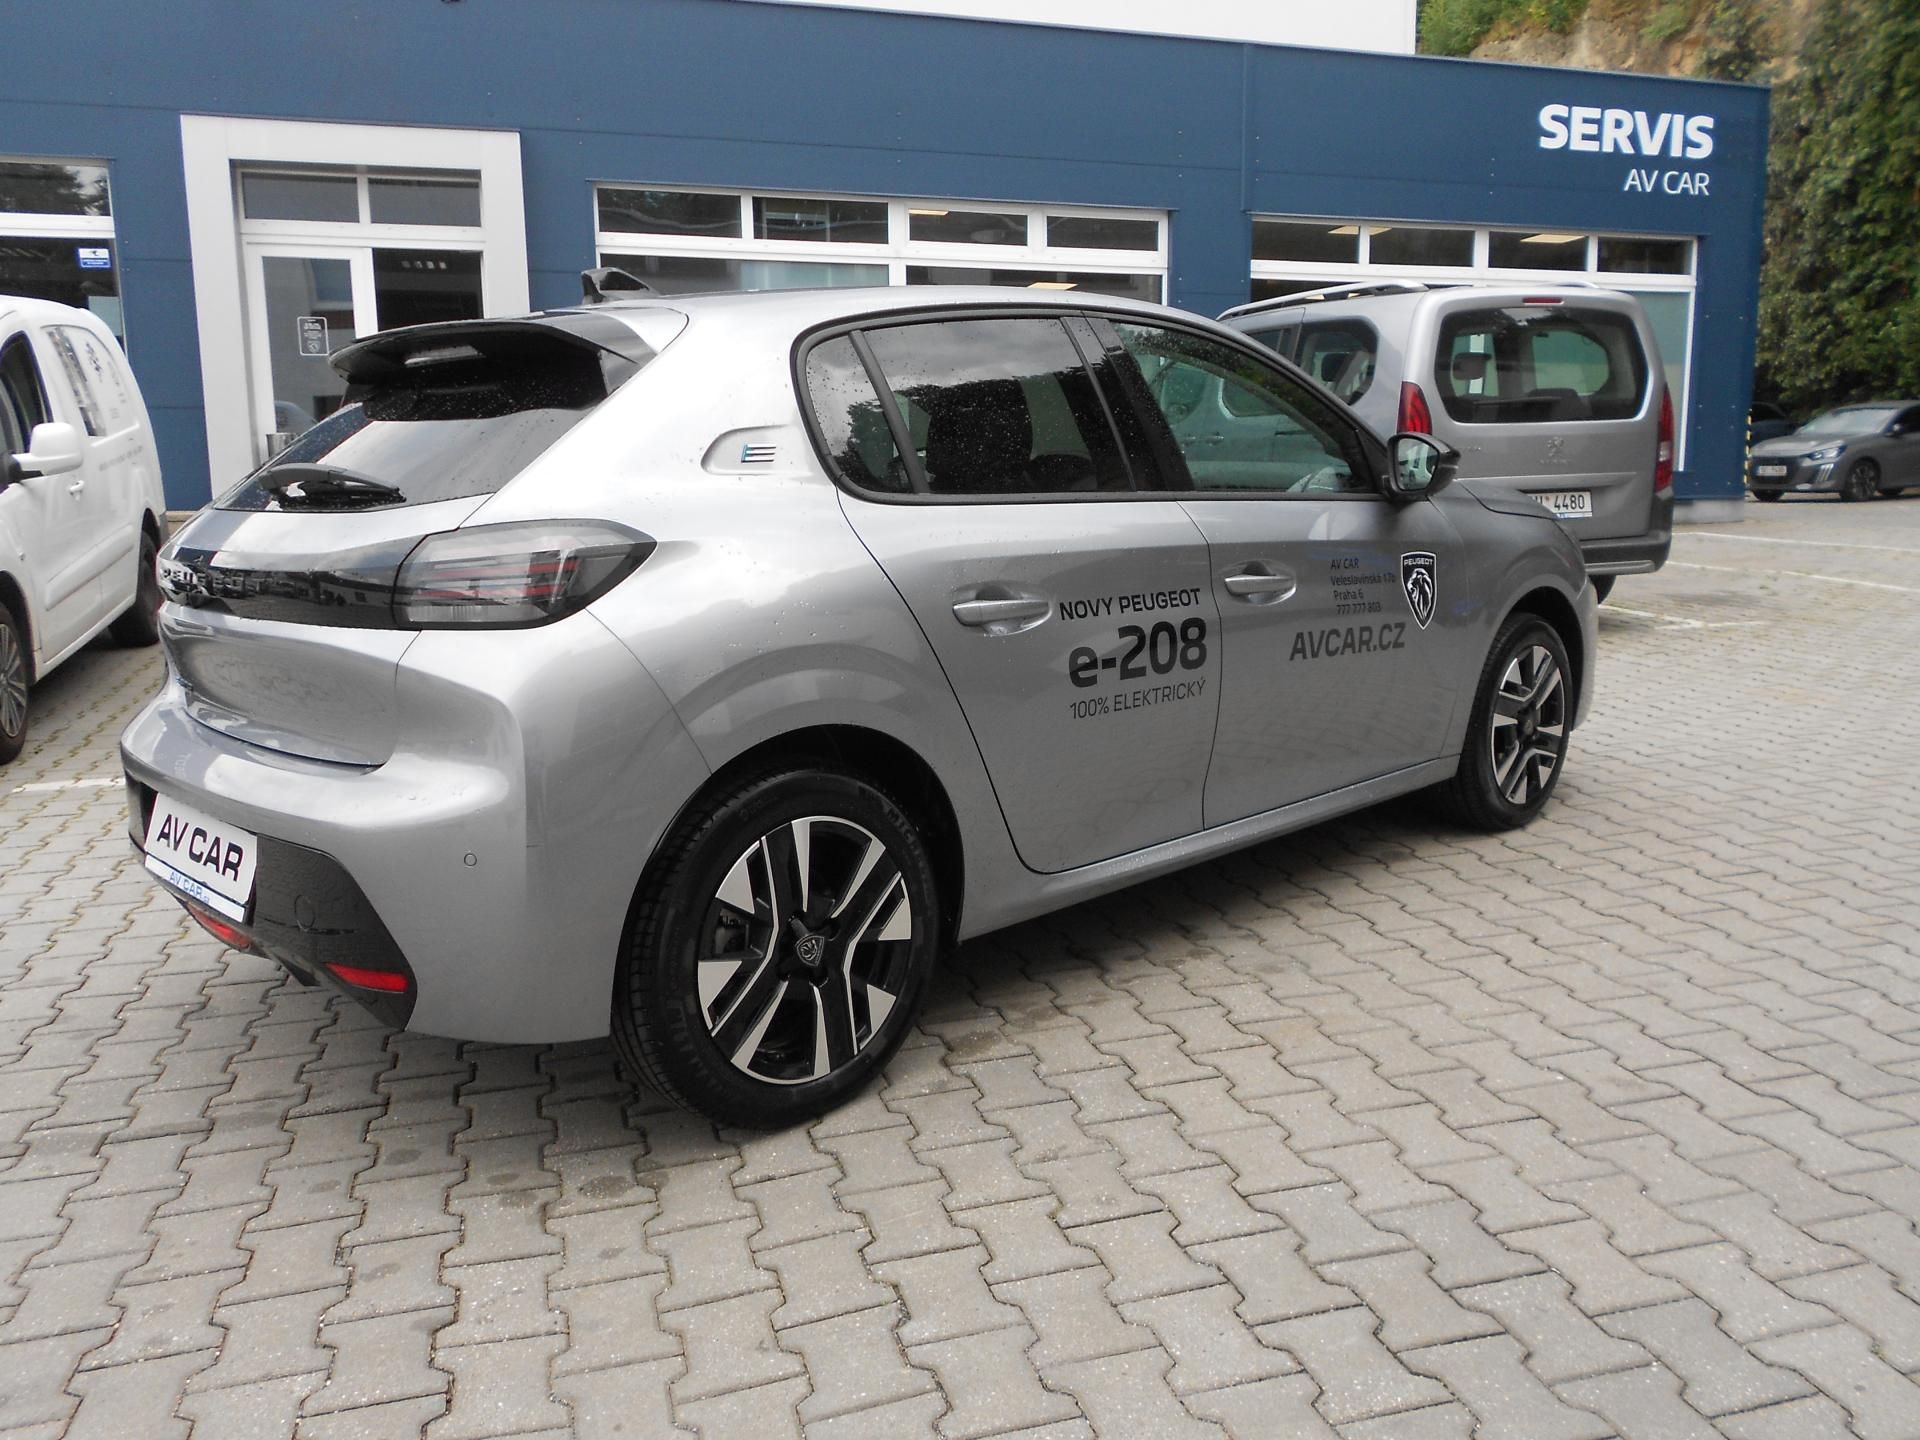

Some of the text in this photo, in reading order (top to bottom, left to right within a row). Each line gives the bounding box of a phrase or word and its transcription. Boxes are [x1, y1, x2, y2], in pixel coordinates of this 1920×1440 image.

[1539, 104, 1715, 159] SERVIS
[1624, 168, 1710, 196] AV CAR
[1554, 494, 1585, 510] 4480
[1330, 558, 1359, 570] AV CAR
[1404, 558, 1433, 566] PEUGEOT
[1119, 588, 1201, 614] PEUGEOT
[1333, 589, 1357, 600] Praha
[1336, 603, 1351, 615] 777
[1352, 602, 1366, 614] 777
[1069, 617, 1208, 688] e-208
[1289, 622, 1406, 661] AVCAR.CZ
[1070, 697, 1110, 719] 100%
[157, 813, 243, 882] AV CAR
